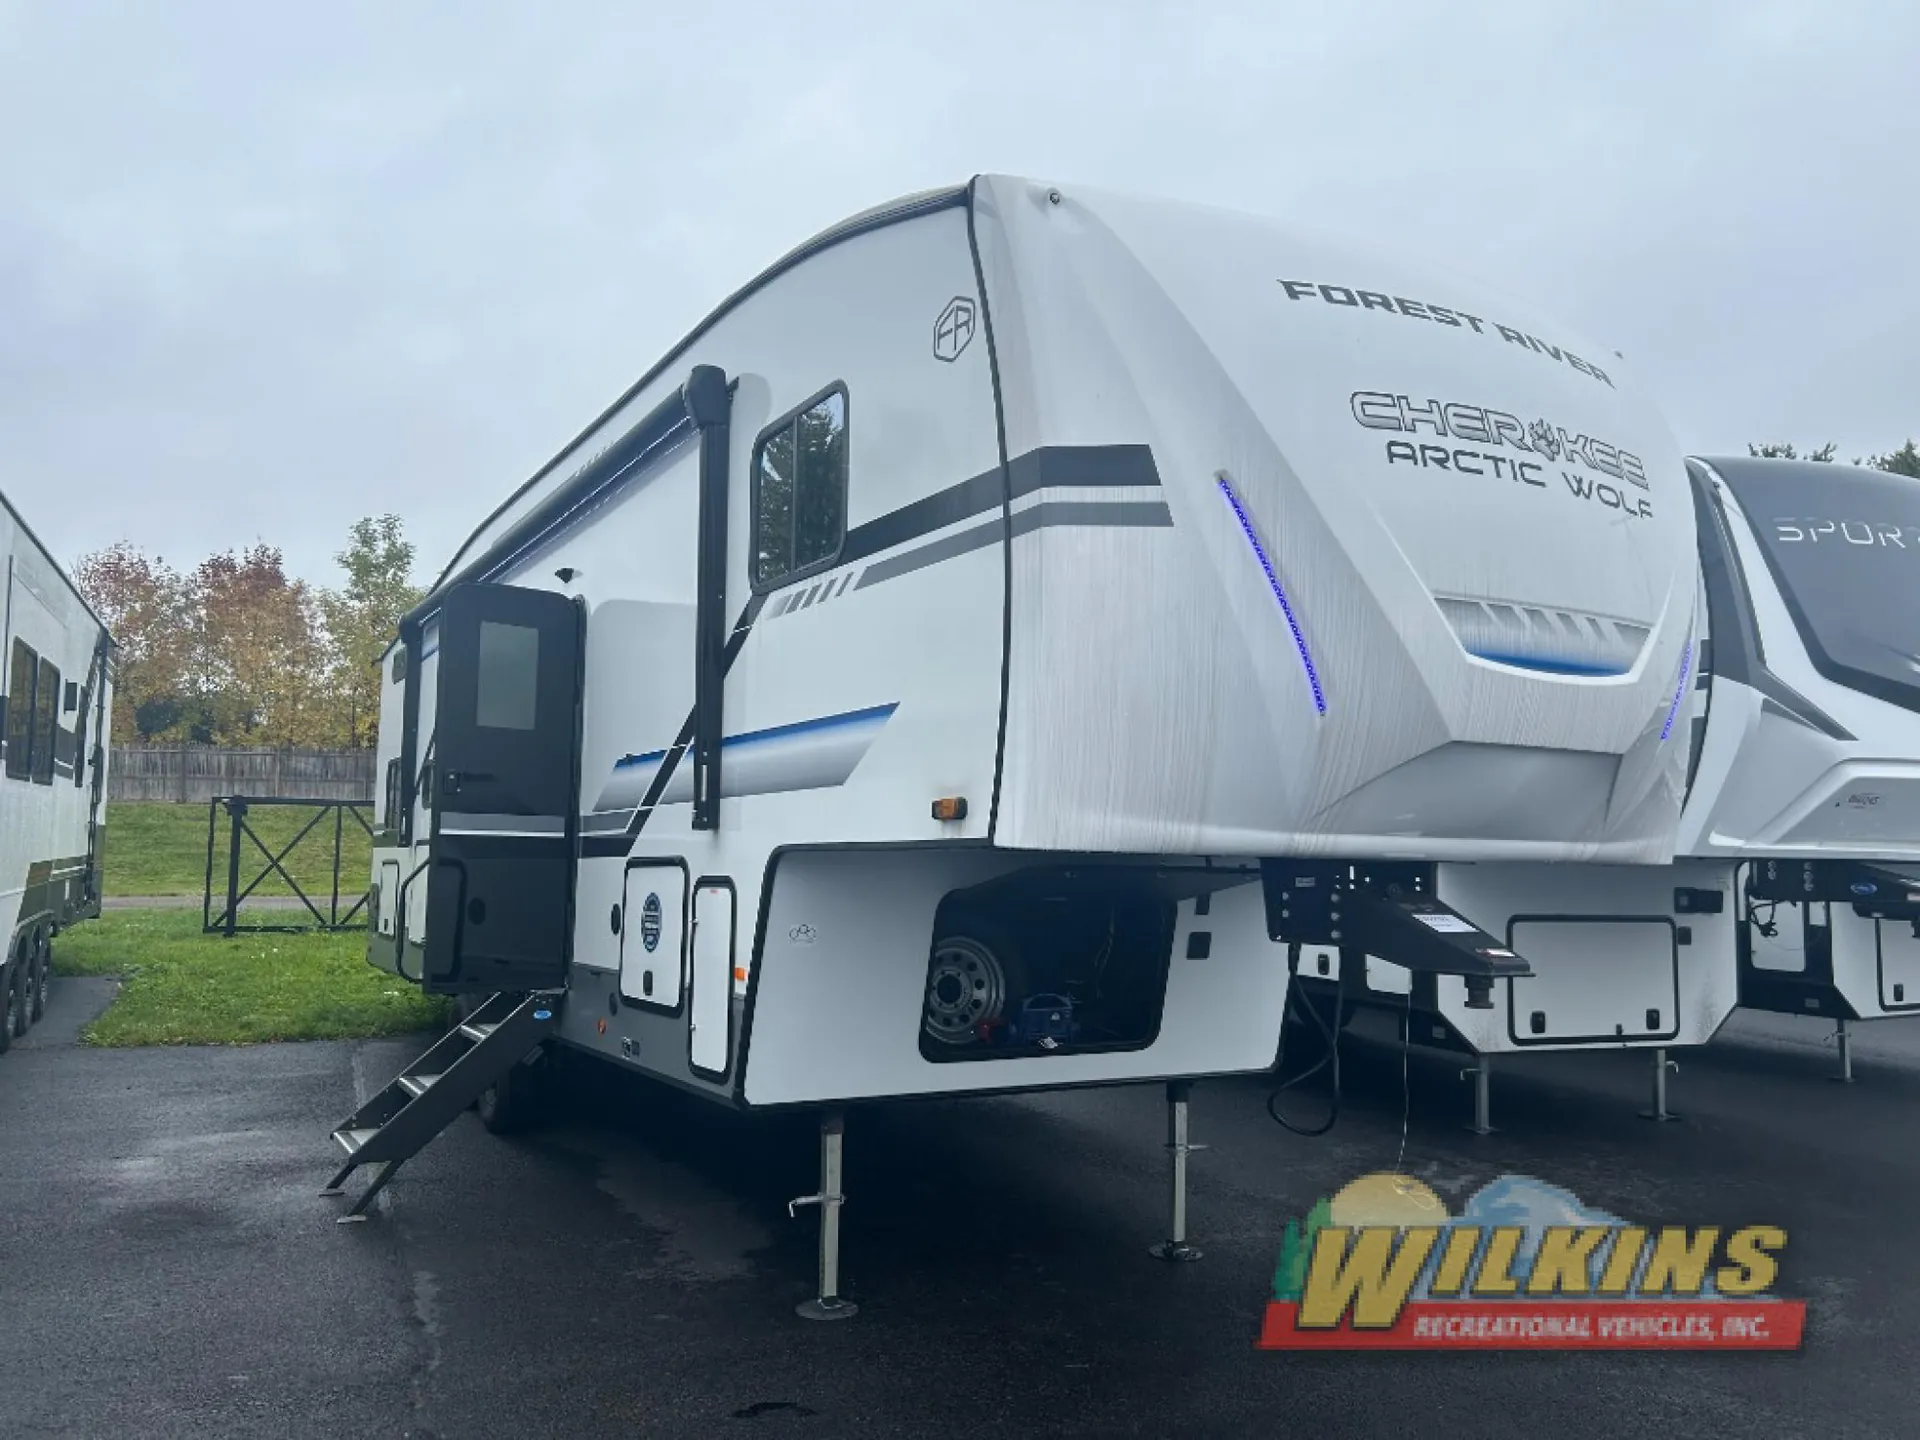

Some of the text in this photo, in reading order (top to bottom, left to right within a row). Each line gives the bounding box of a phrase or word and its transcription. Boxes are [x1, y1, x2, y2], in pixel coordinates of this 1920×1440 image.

[1276, 278, 1617, 390] FOREST RIVER
[1386, 440, 1654, 518] ARCTIC WOLF
[1773, 517, 1920, 549] SPOR
